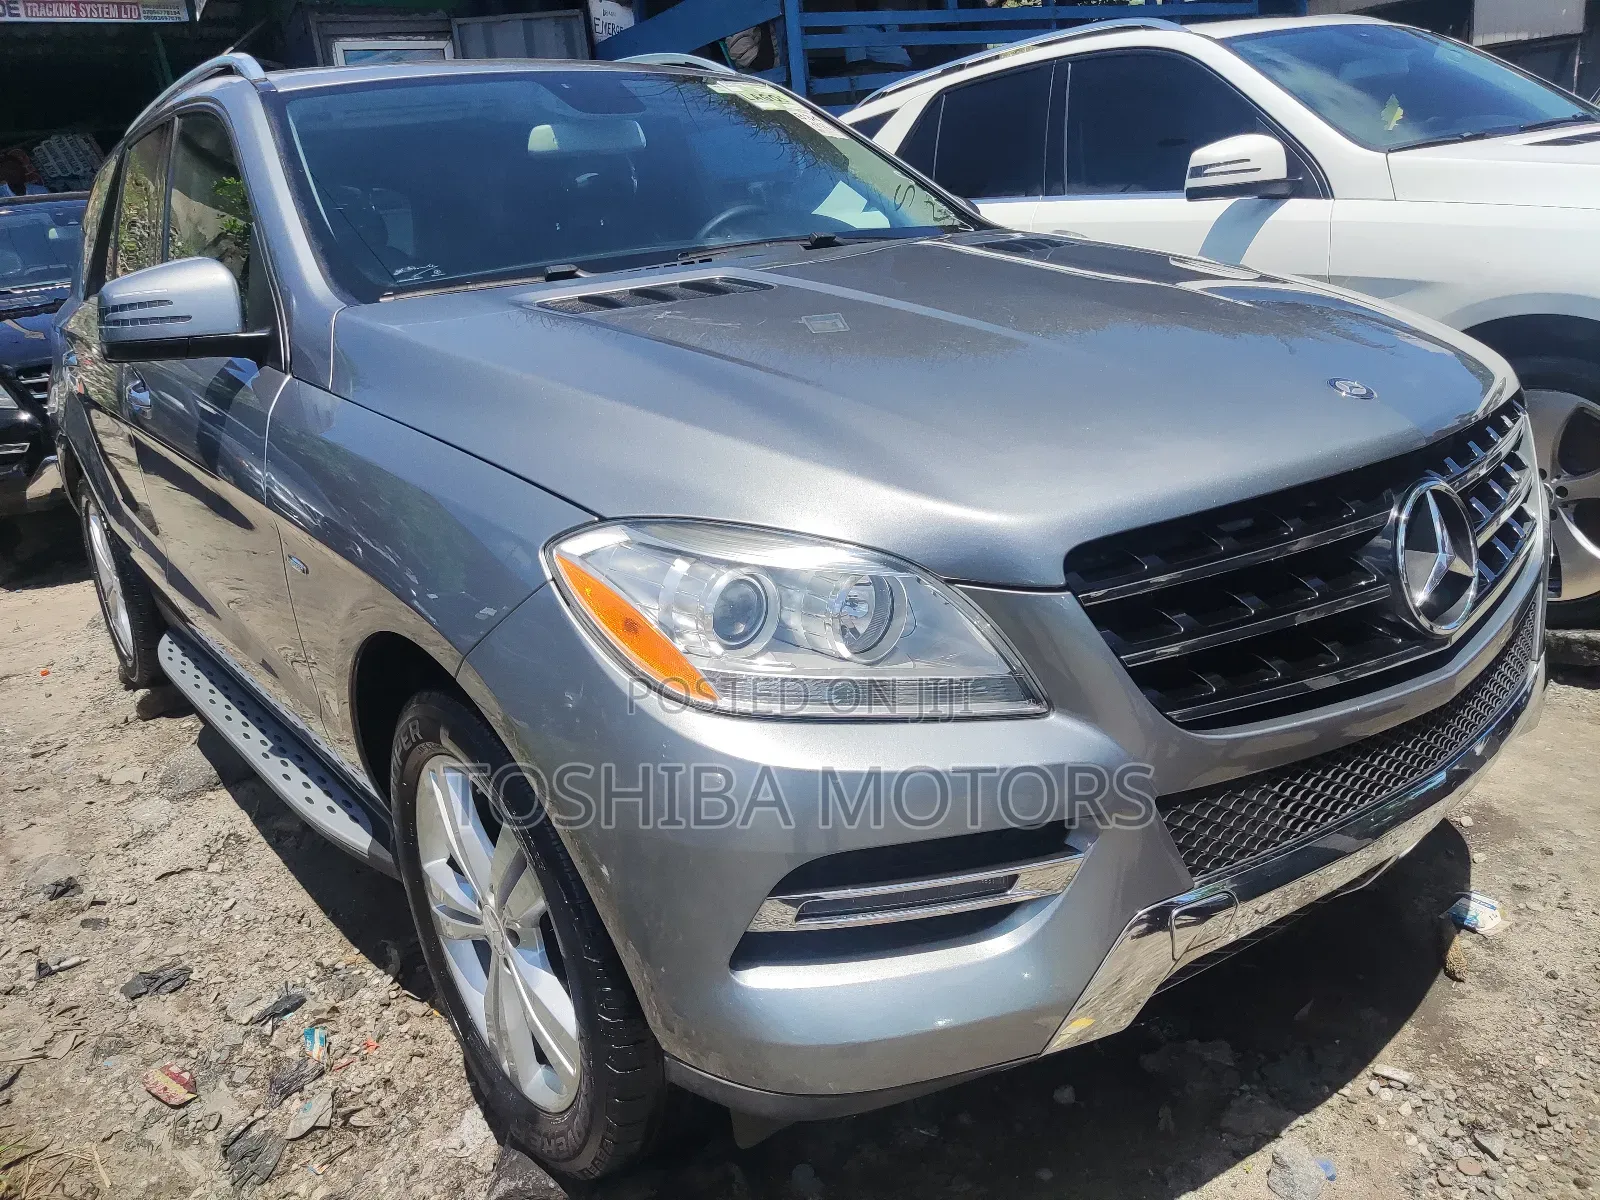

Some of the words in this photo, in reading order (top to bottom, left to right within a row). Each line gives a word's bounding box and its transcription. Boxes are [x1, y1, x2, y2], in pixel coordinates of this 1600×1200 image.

[26, 3, 77, 17] TRACKING
[79, 3, 119, 18] SYSTEM
[121, 4, 139, 19] LTD
